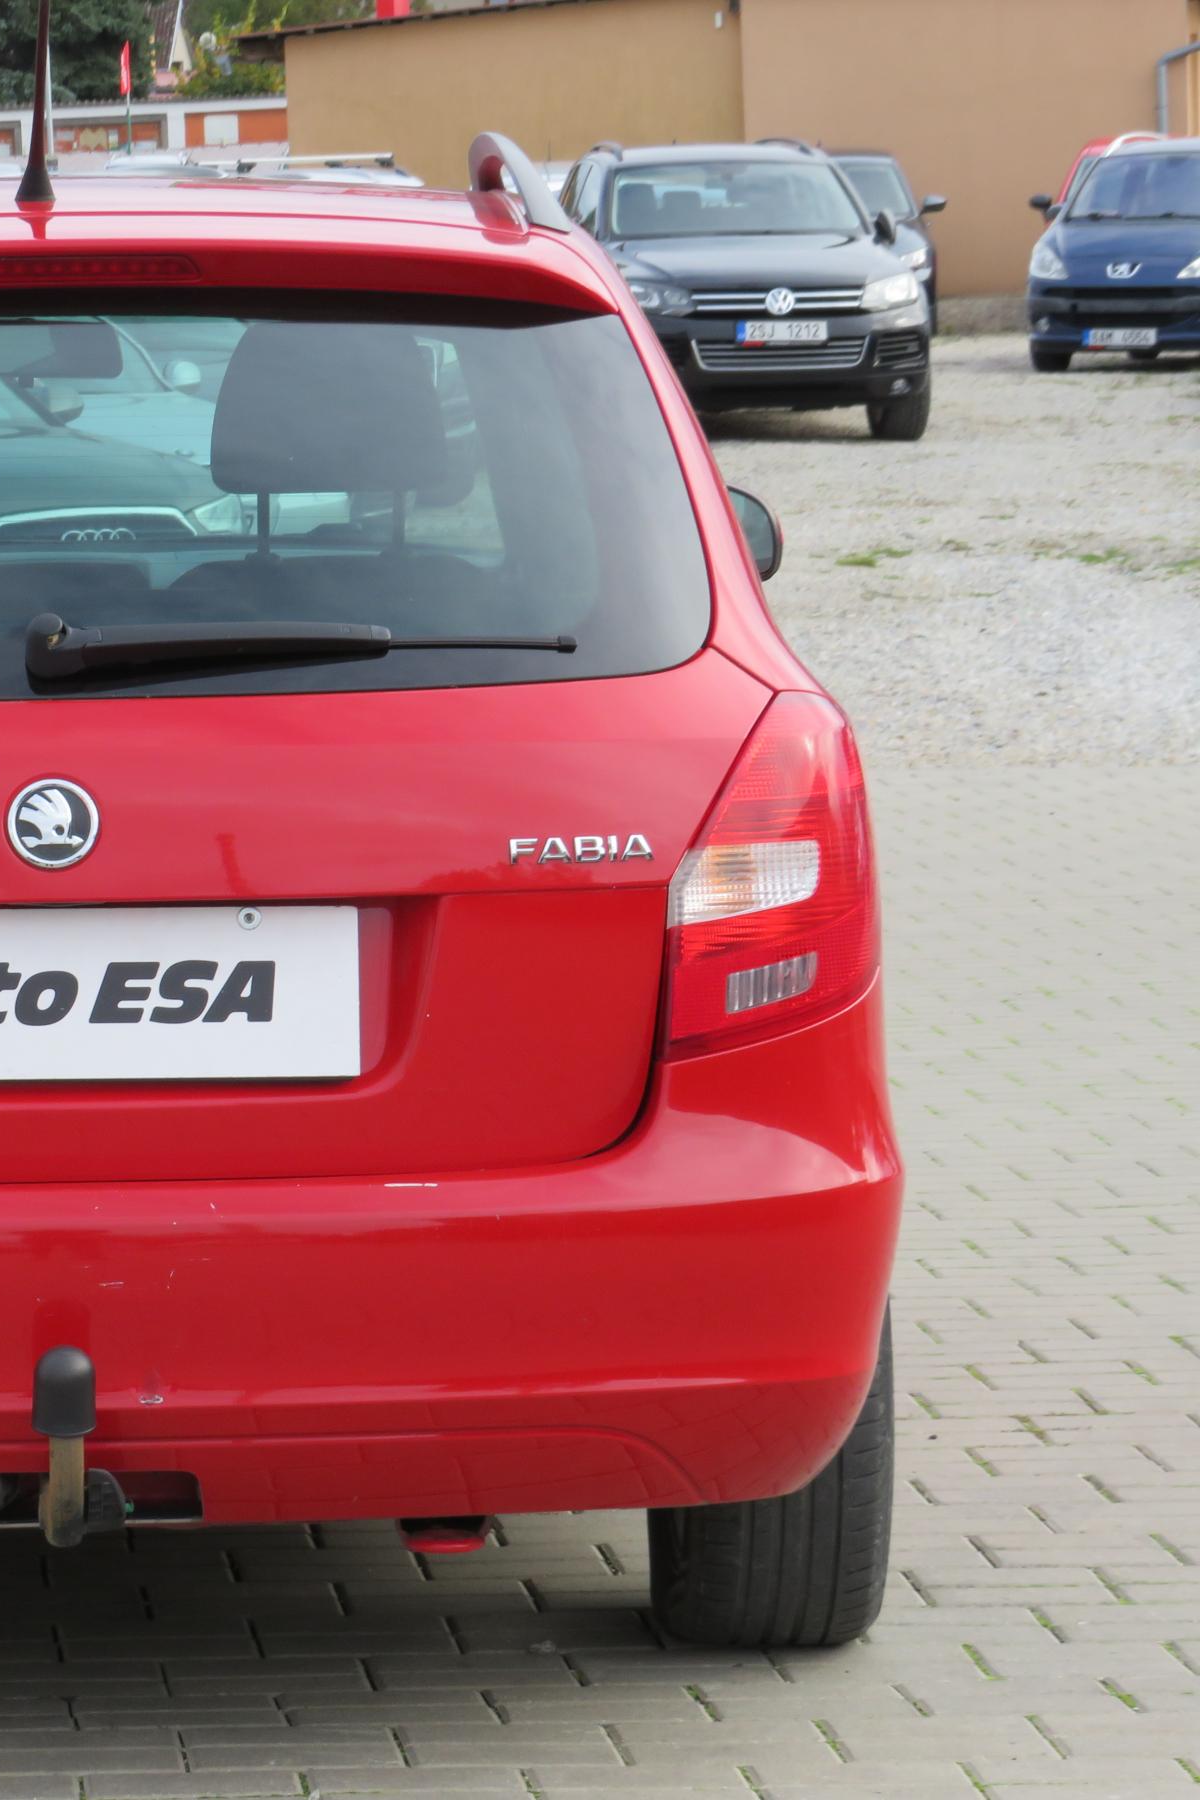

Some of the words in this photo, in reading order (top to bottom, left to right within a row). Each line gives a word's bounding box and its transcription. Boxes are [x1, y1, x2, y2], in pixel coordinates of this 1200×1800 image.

[749, 324, 775, 338] 2SJ
[787, 323, 820, 338] 1212
[508, 834, 653, 865] FABIA
[88, 959, 276, 1024] ESA
